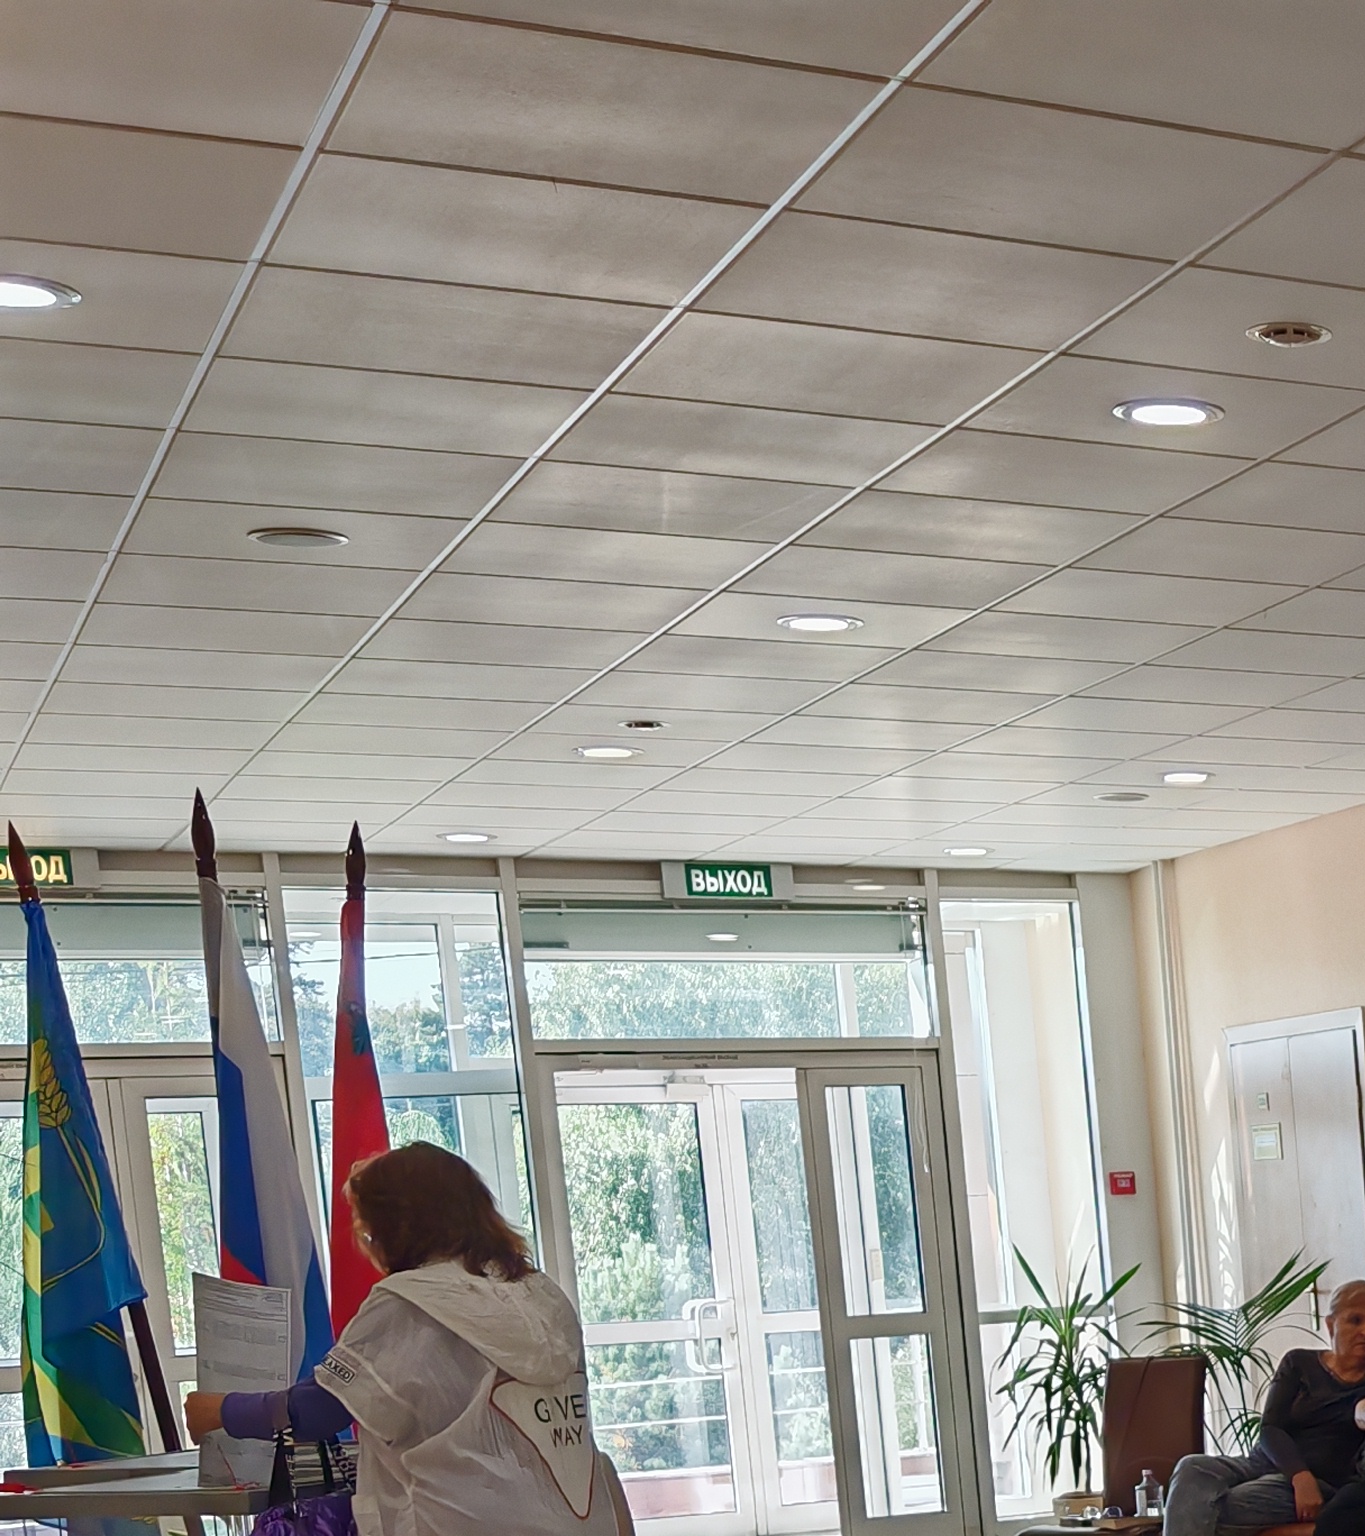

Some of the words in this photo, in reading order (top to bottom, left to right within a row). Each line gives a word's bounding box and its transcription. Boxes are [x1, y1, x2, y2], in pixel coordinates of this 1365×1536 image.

[690, 869, 768, 895] ВЫХОД
[534, 1394, 587, 1423] GVE
[550, 1425, 582, 1448] WAY
